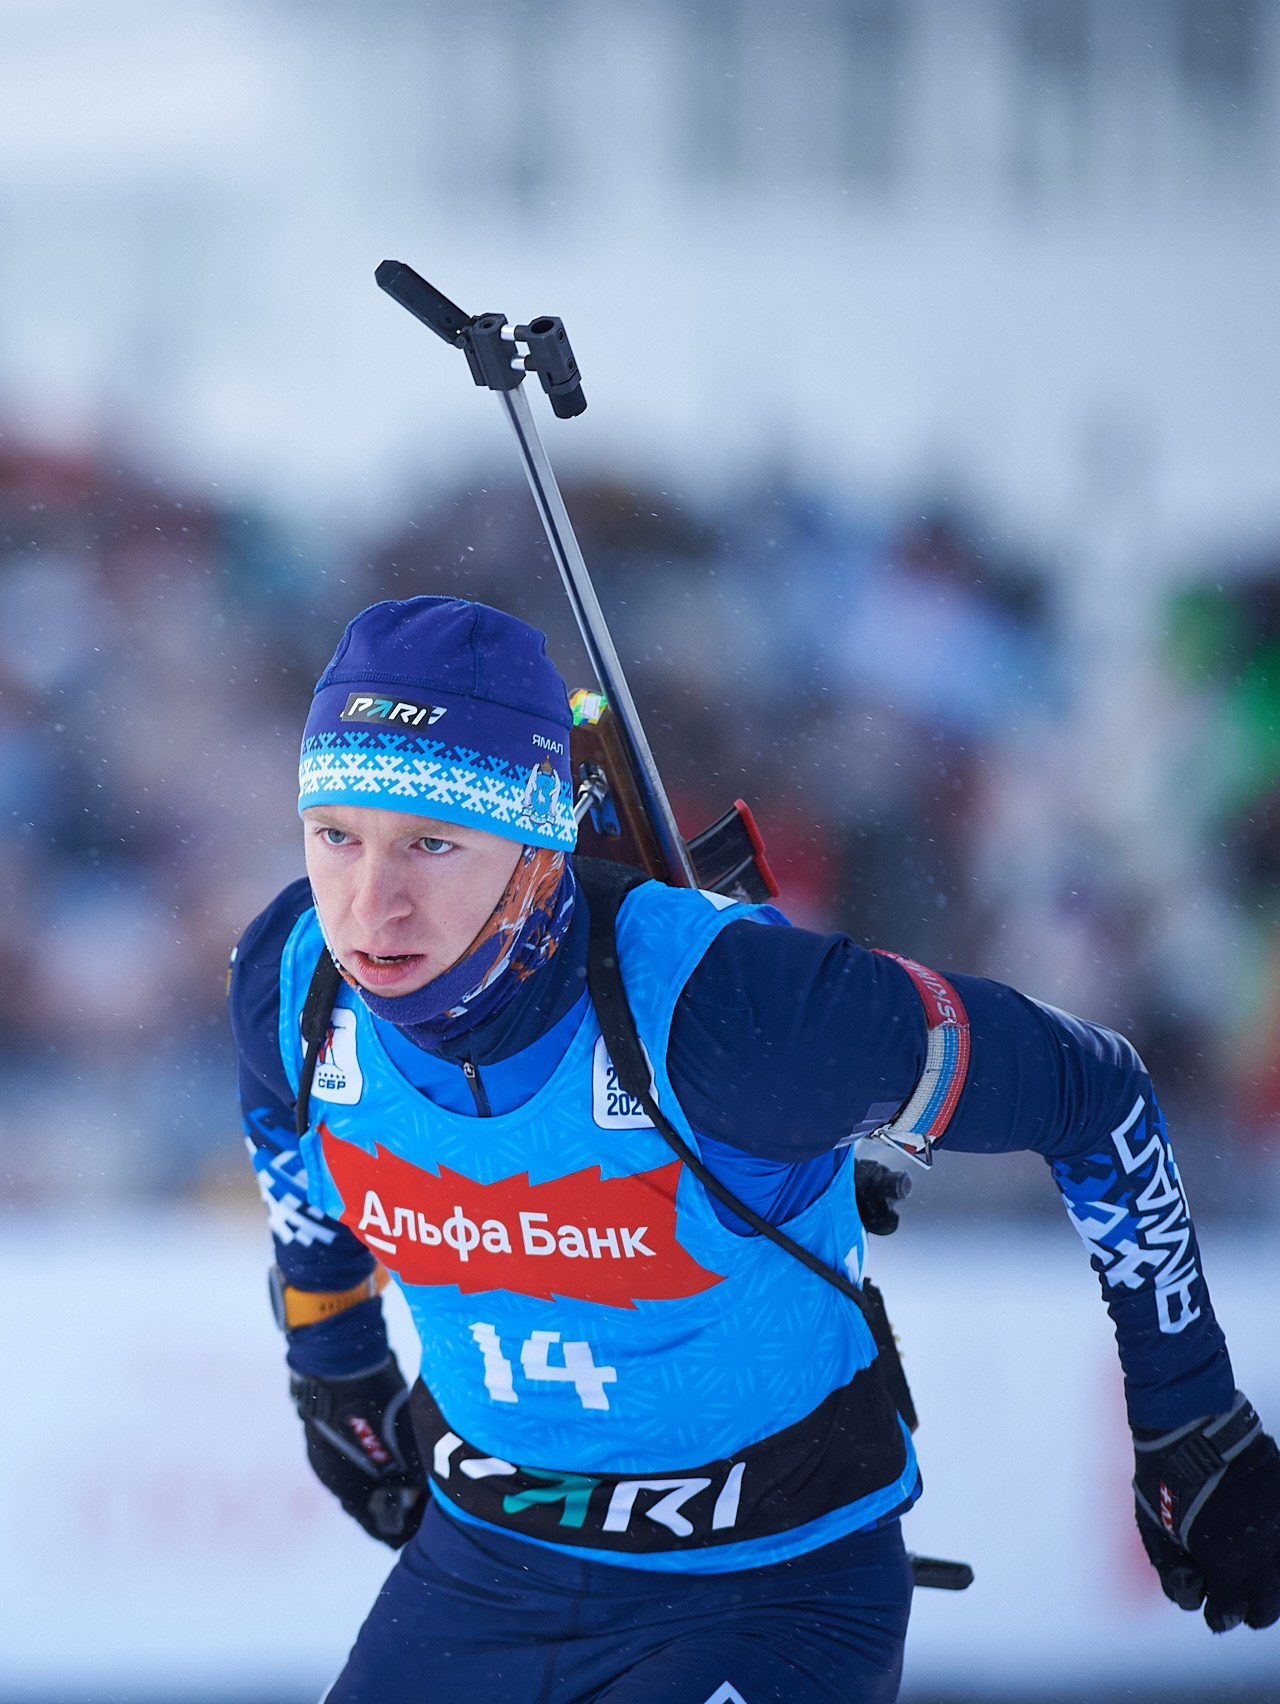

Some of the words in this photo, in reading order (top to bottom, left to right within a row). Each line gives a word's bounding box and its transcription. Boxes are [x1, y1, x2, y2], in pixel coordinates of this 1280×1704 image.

[347, 697, 427, 726] PARI
[531, 733, 564, 756] ЯМАЛ
[318, 1078, 346, 1090] СБР
[607, 1092, 649, 1116] 202
[358, 1189, 513, 1262] Альфа
[519, 1211, 656, 1259] Банк
[1111, 1095, 1200, 1334] ЯМАЛ
[468, 1322, 617, 1410] 14
